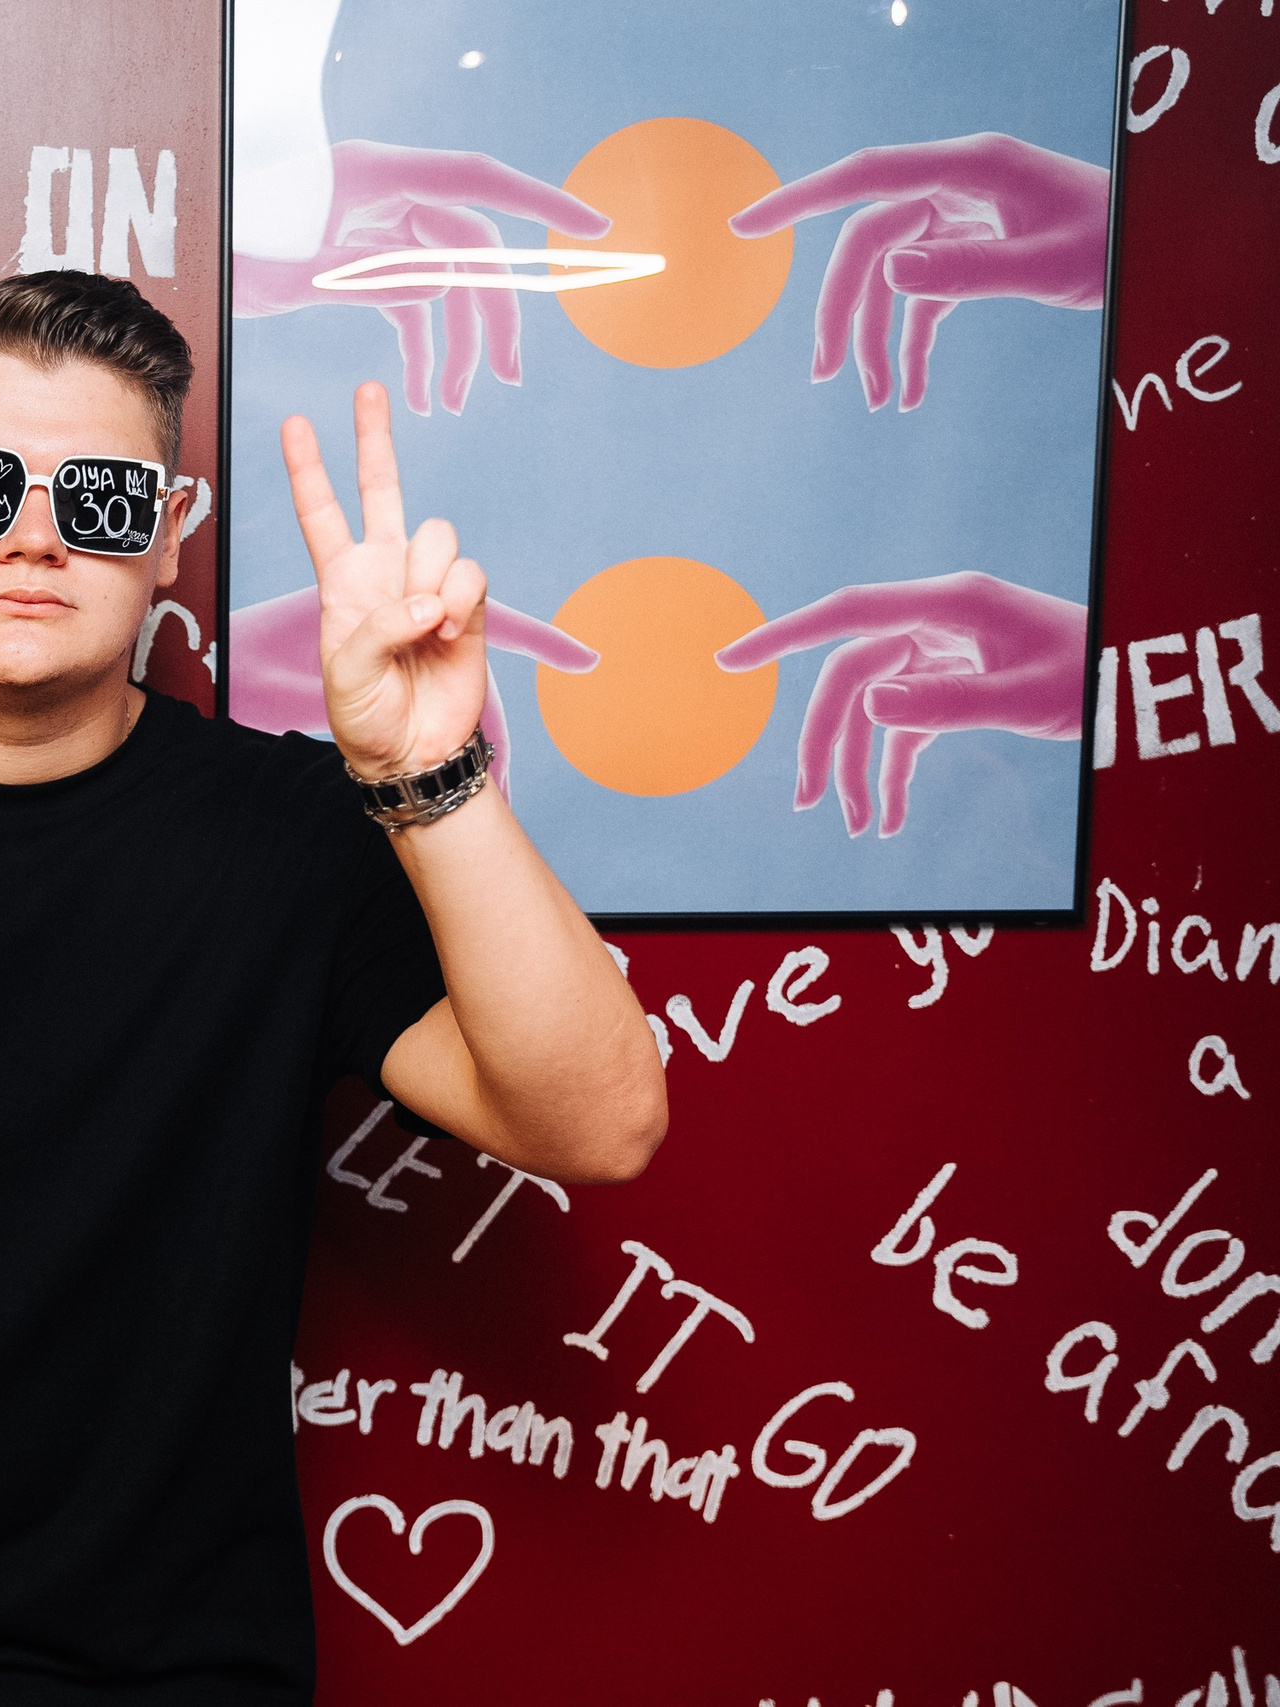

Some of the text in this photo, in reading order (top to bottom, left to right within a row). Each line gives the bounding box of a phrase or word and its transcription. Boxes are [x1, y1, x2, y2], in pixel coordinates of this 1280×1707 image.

[17, 145, 178, 278] ON
[71, 493, 132, 539] 30
[564, 1240, 755, 1393] IT
[871, 1162, 1018, 1329] be
[410, 1368, 573, 1479] than
[596, 1411, 740, 1523] that
[752, 1380, 917, 1521] GO
